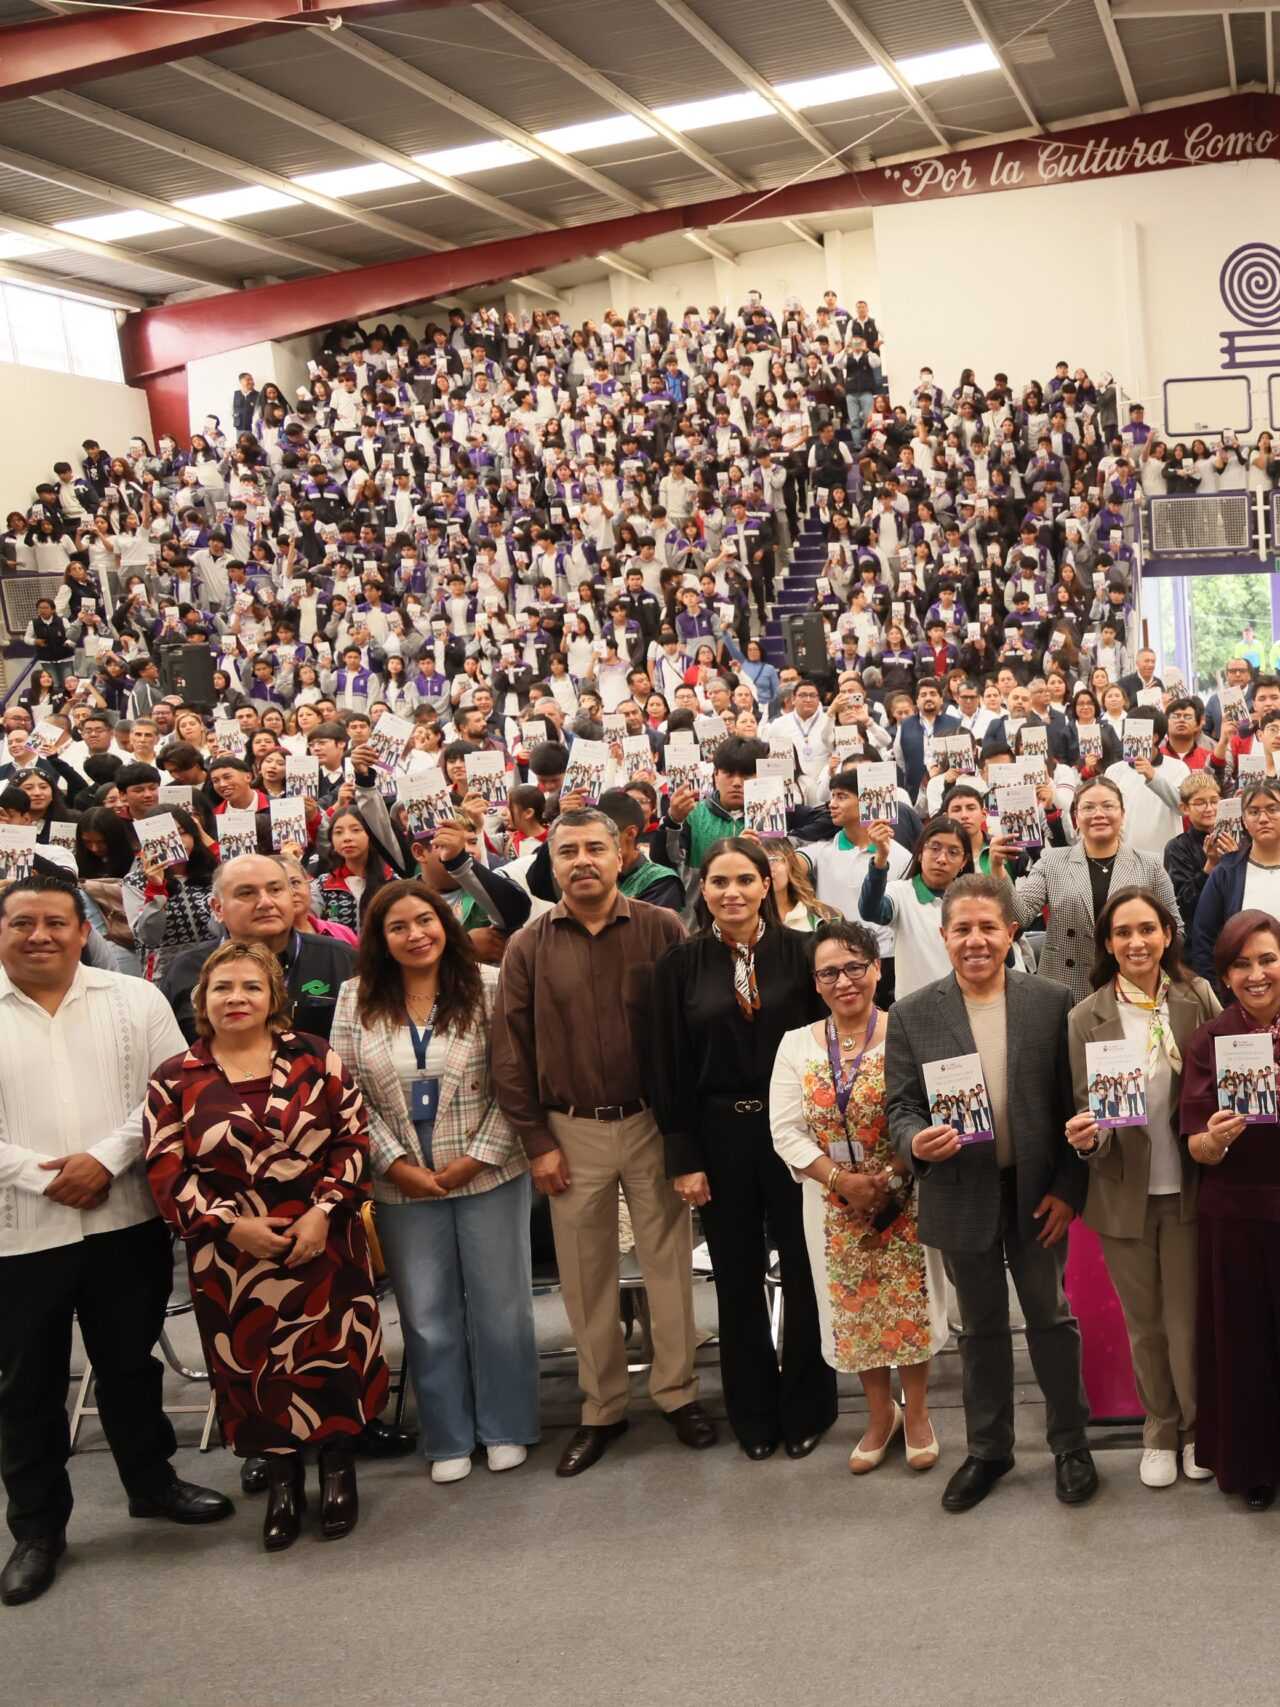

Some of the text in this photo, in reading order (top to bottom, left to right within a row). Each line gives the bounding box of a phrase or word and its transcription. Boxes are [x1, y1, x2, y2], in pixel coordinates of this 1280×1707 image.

[990, 152, 1024, 186] la
[1038, 137, 1173, 183] Cultura
[1185, 122, 1280, 164] Como
